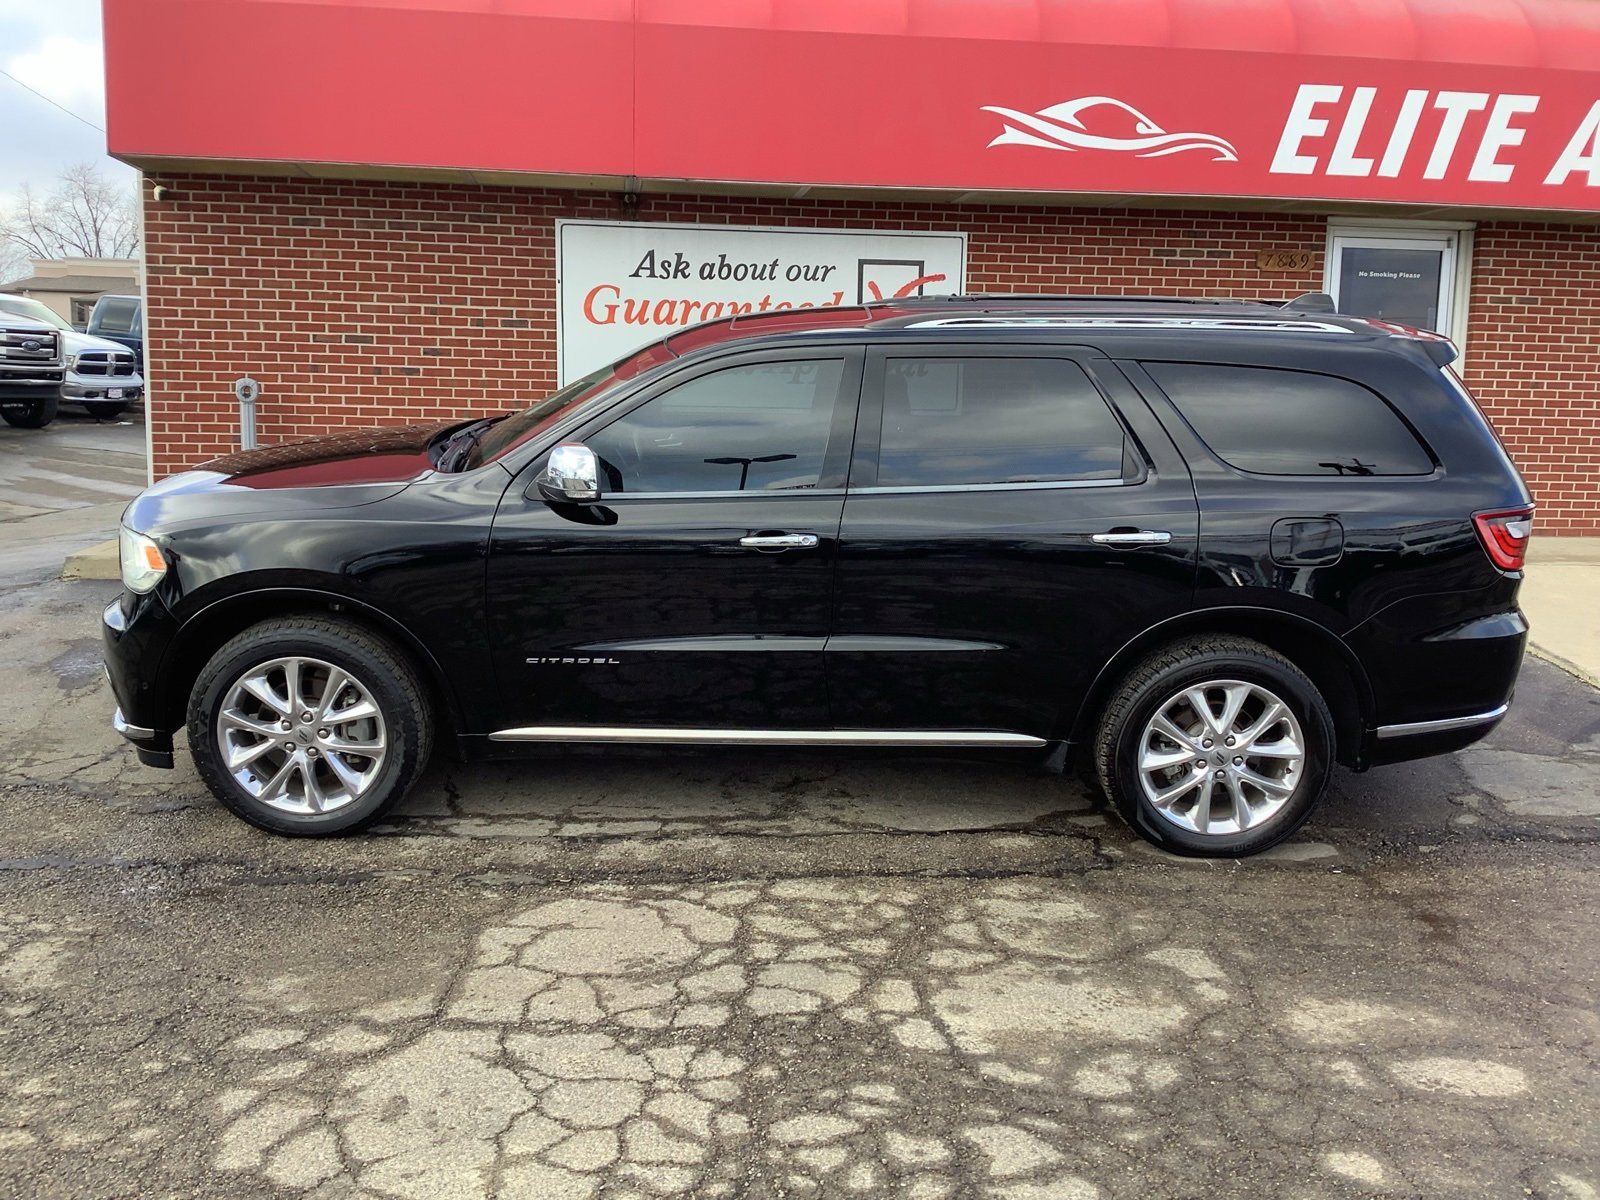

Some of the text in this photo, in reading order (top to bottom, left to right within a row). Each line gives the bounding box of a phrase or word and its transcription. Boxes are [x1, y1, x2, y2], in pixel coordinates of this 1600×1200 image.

[1269, 83, 1541, 183] ELITE
[629, 248, 837, 282] Ask about our
[1264, 253, 1310, 269] 7889
[1369, 271, 1398, 279] Smoking
[583, 284, 845, 327] Guarant
